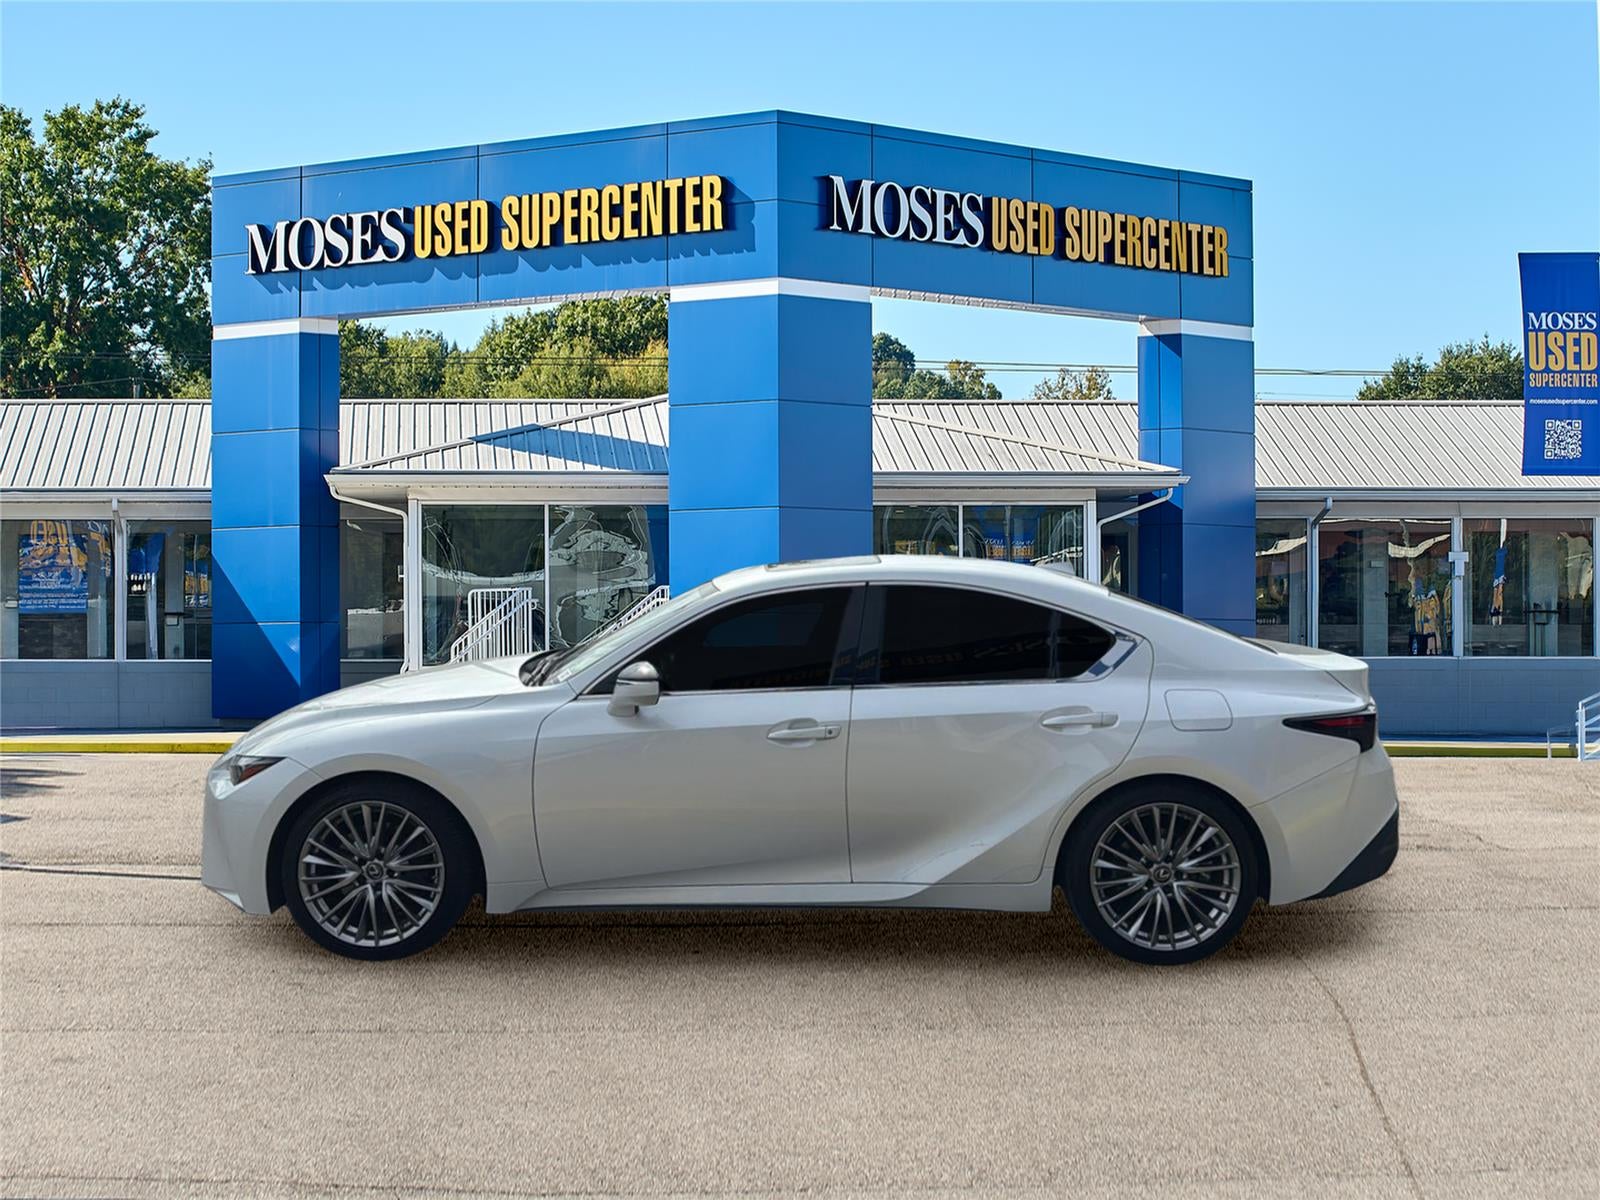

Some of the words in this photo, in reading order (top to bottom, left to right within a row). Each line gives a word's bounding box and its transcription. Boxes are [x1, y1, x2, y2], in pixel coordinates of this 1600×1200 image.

[243, 207, 407, 275] MOSES
[413, 199, 489, 259] USED
[500, 174, 724, 252] SUPERCENTER
[827, 174, 985, 249] MOSES
[991, 196, 1055, 257] USED
[1064, 206, 1229, 278] SUPERCENTER
[1527, 312, 1597, 330] MOSES
[1528, 331, 1598, 371] USED
[1529, 372, 1598, 388] SUPERCENTER
